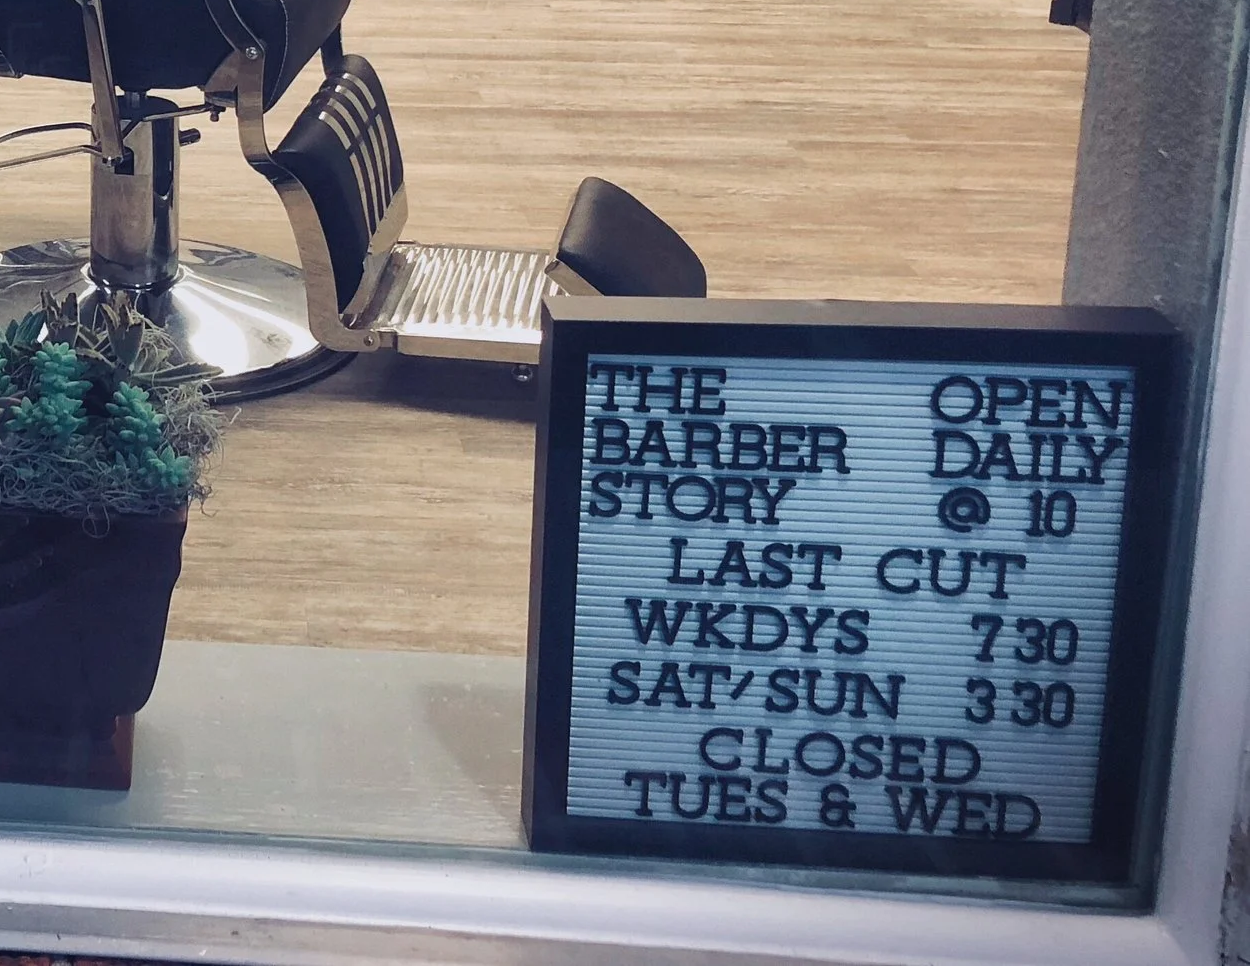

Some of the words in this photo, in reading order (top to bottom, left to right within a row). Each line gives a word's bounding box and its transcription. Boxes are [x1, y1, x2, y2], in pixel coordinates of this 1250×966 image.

[590, 364, 727, 415] THE
[930, 375, 1127, 429] OPEN
[590, 418, 850, 474] BARBER
[929, 430, 1124, 484] DAILY
[589, 472, 797, 525] STORY
[938, 487, 991, 533] @
[1025, 489, 1077, 537] 10
[667, 537, 842, 590] LAST
[877, 548, 1027, 599] CUT
[624, 598, 870, 654] WKDYS
[699, 727, 981, 785] CLOSED
[624, 770, 789, 824] TUES
[820, 783, 857, 828] &
[884, 785, 1042, 839] WED
